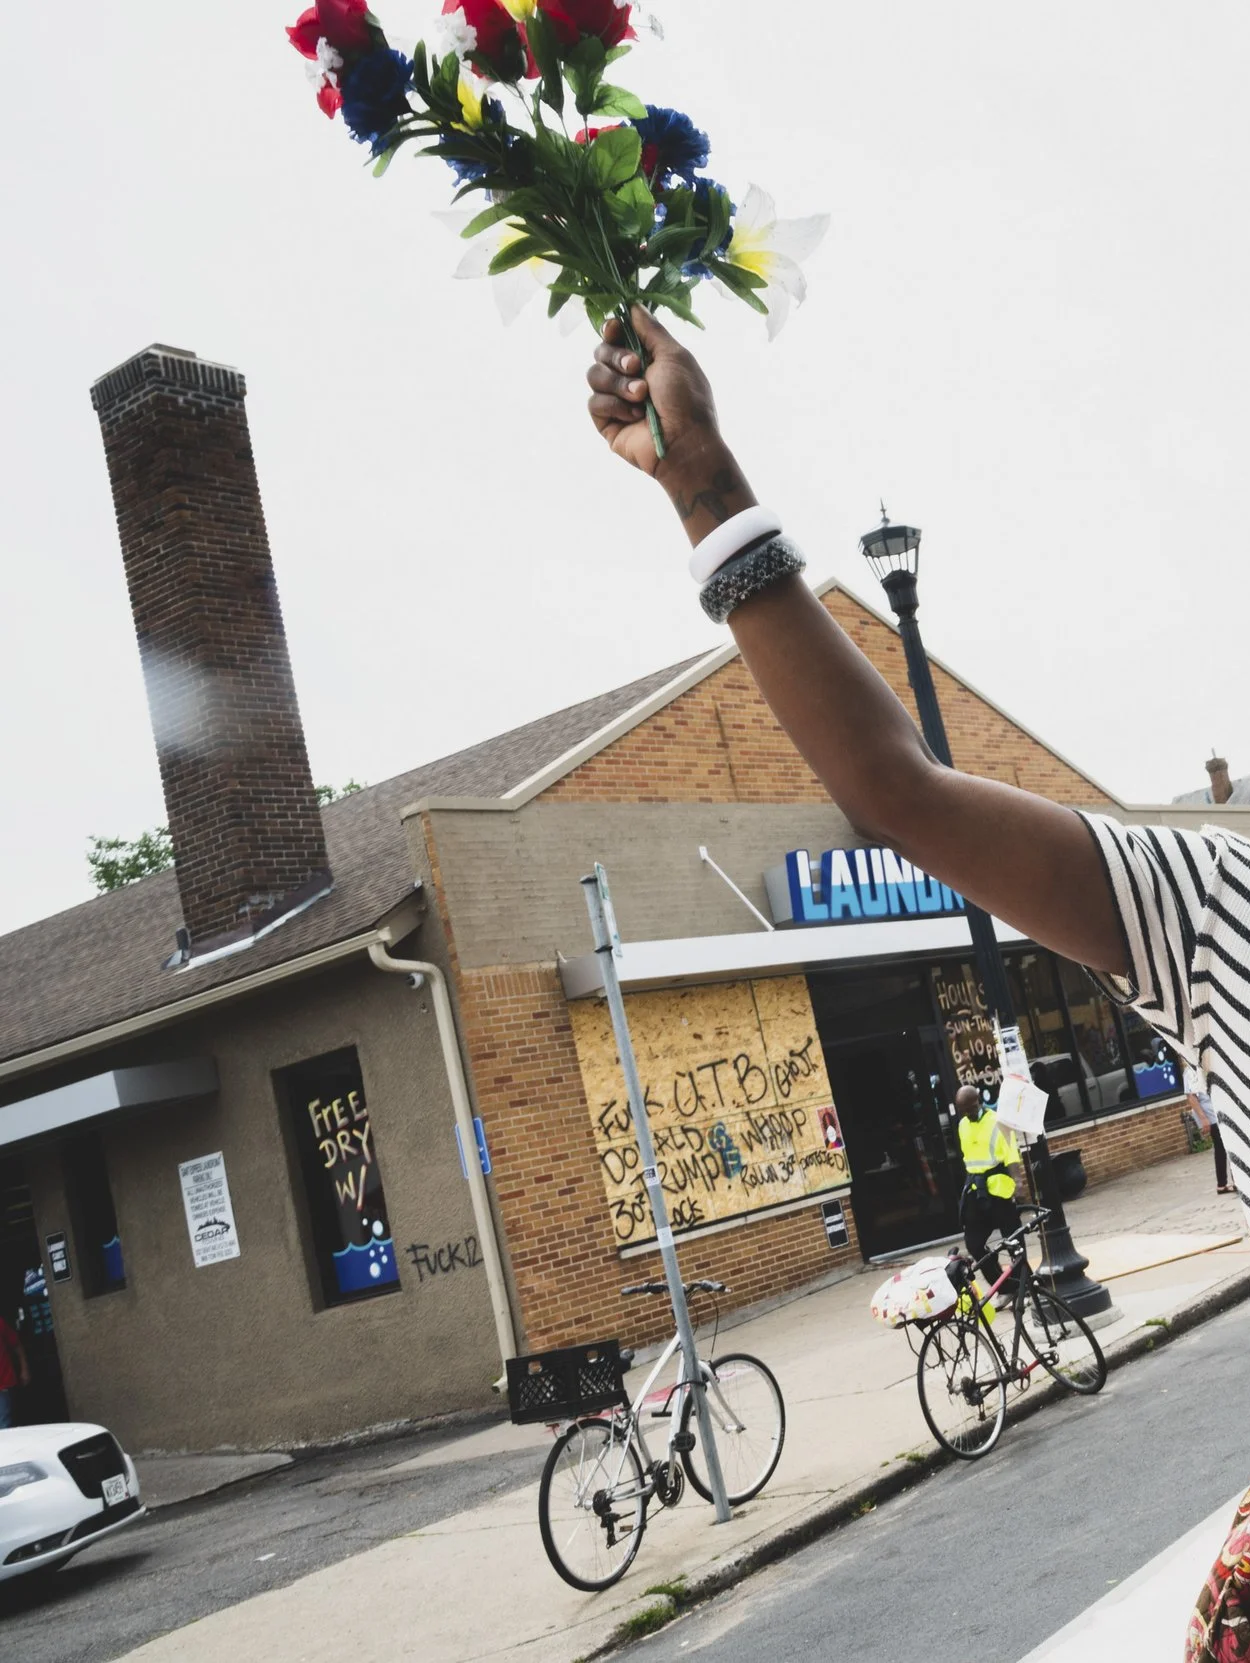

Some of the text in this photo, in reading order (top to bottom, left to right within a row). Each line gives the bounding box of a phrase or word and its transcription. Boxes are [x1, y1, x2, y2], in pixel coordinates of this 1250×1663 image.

[599, 1085, 664, 1141] FUK
[319, 1121, 372, 1168] DRY
[600, 1125, 704, 1184] DOALD
